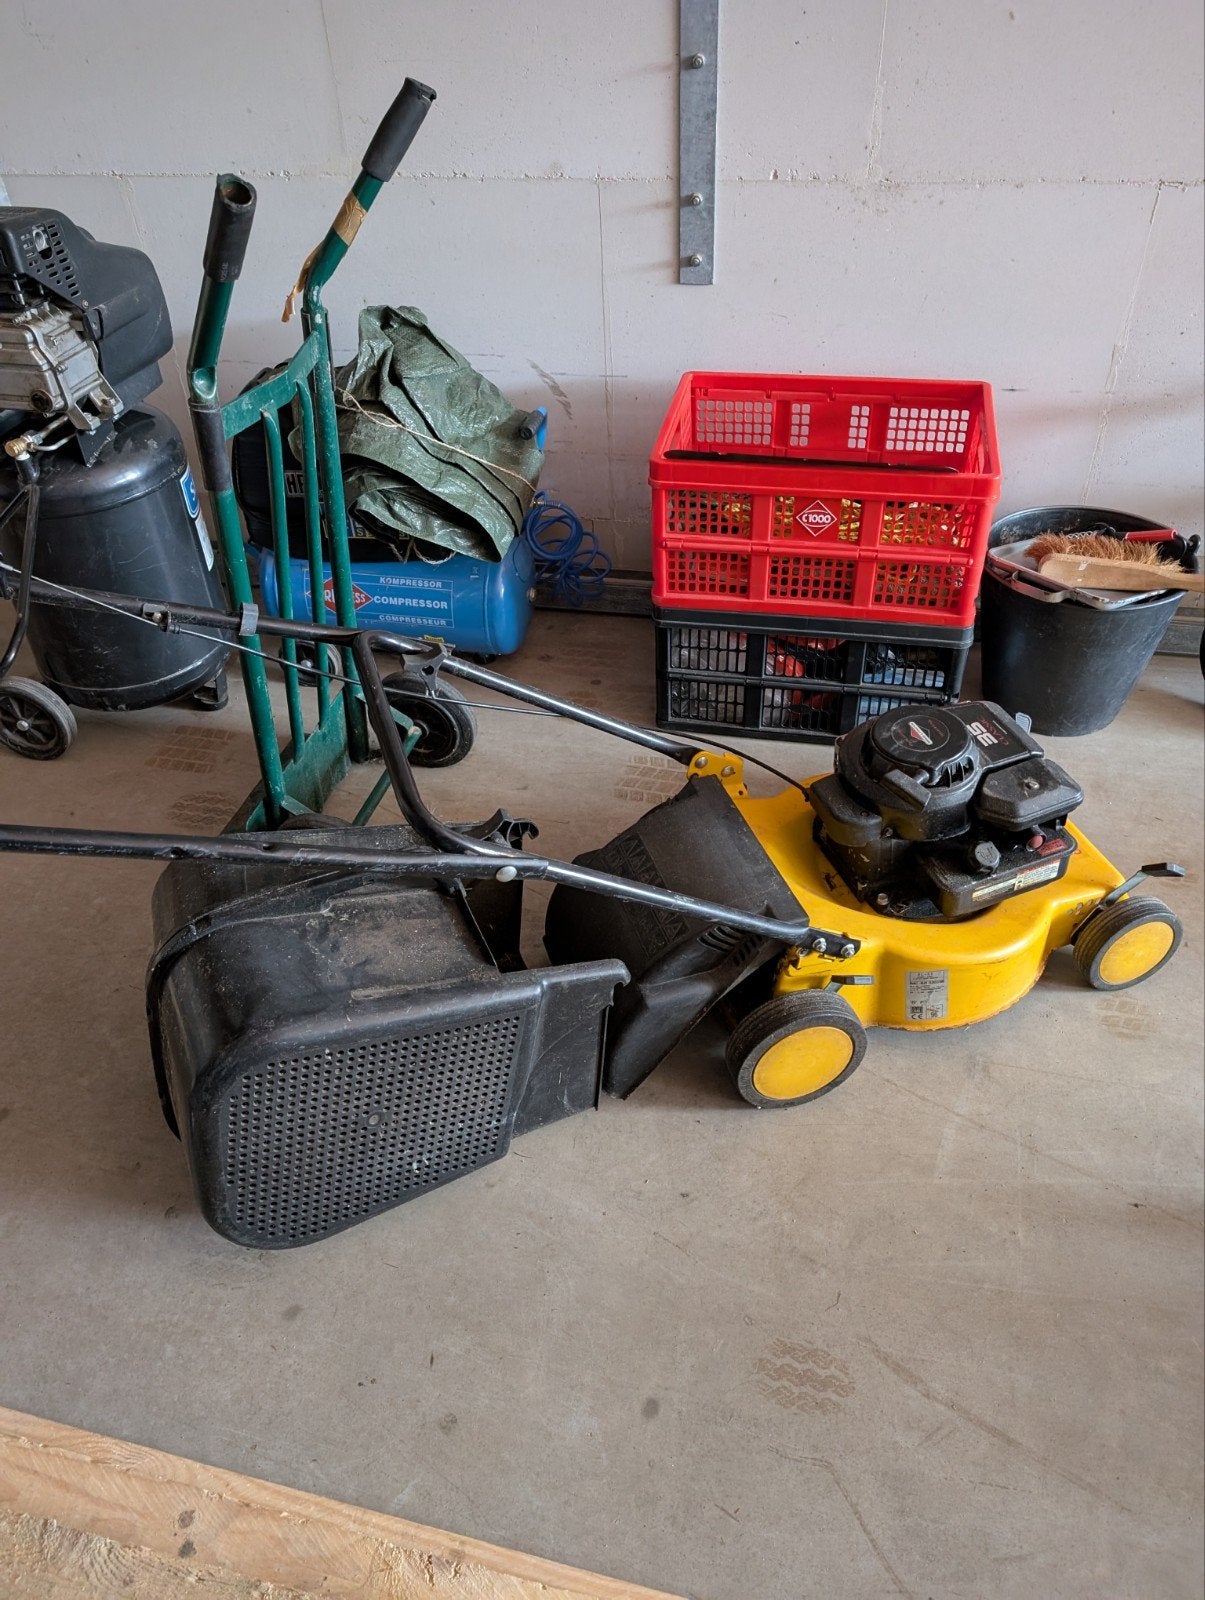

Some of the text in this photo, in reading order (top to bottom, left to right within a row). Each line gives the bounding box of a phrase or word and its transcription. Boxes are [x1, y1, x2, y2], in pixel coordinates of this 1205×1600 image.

[801, 513, 832, 524] C1000
[379, 576, 443, 589] KOMPRESSOR
[373, 595, 448, 610] COMPRESSOR
[379, 613, 447, 626] COMPRESSEUR
[965, 721, 999, 747] 35
